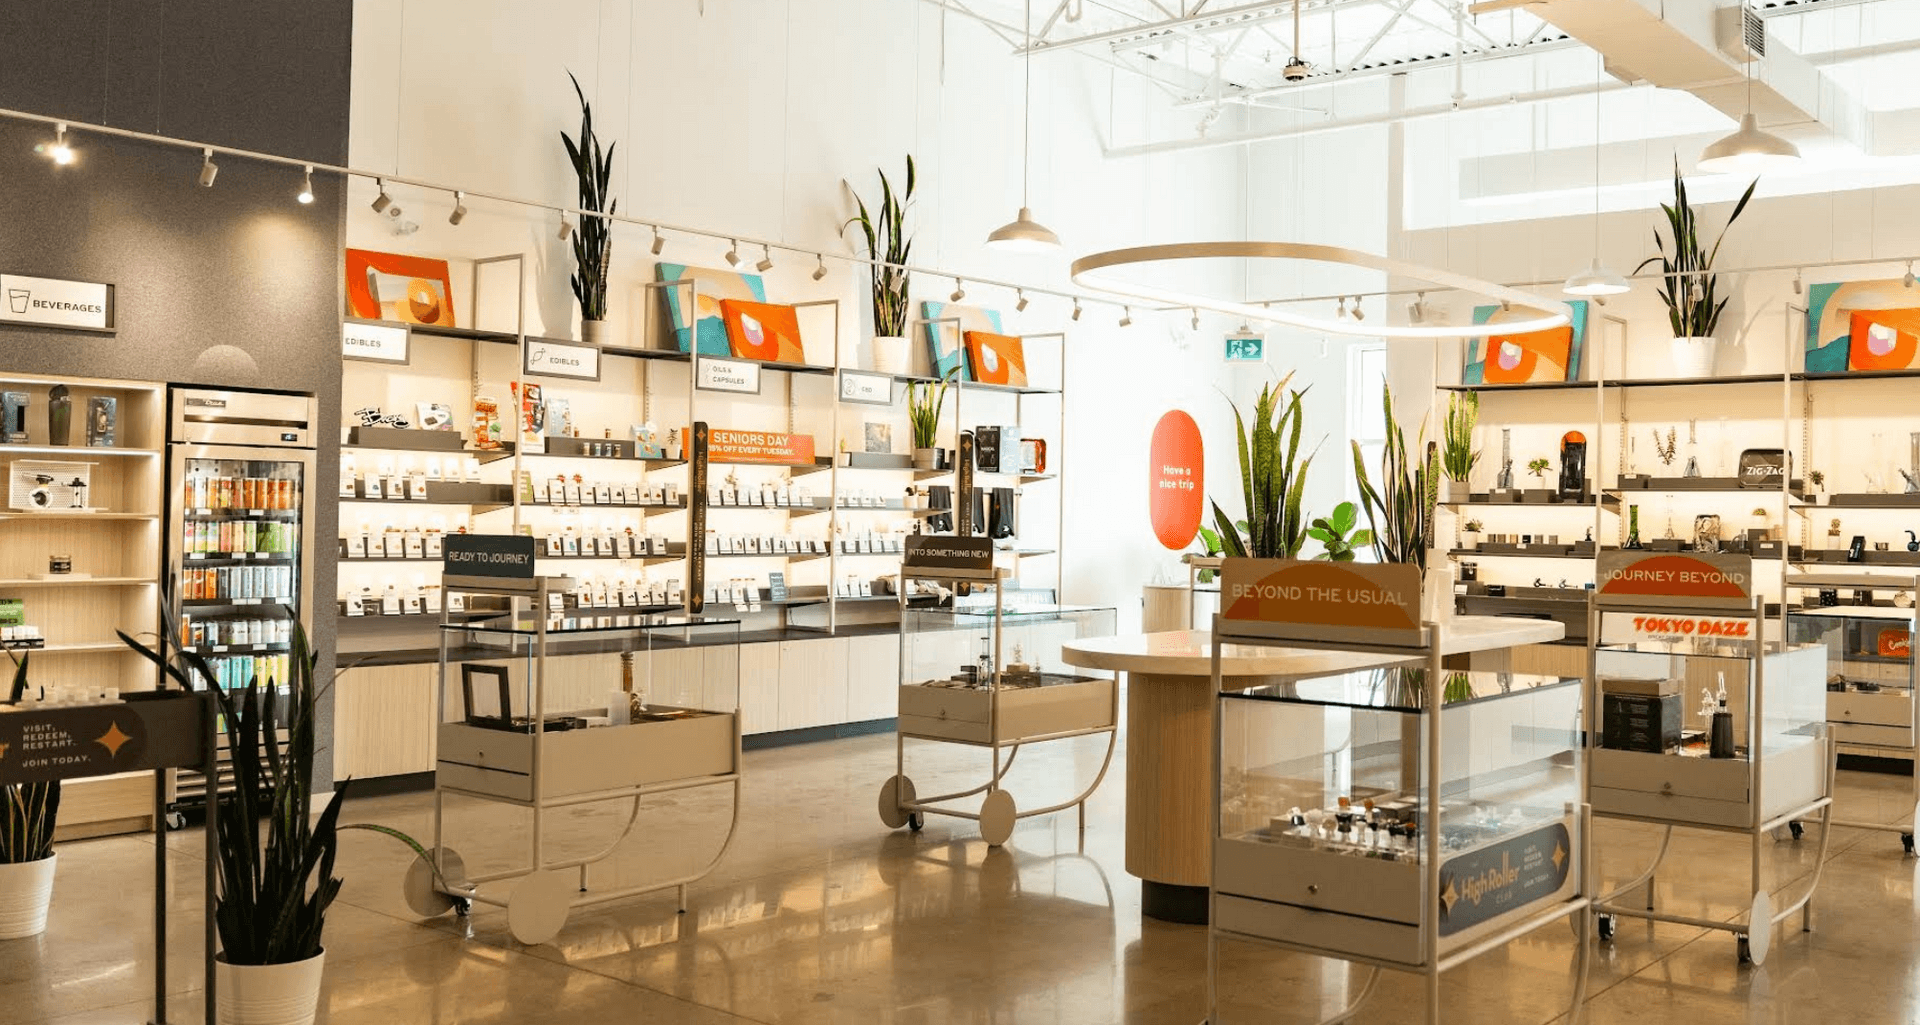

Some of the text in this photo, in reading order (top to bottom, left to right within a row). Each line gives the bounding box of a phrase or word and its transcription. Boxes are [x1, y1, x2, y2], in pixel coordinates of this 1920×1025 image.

[33, 299, 102, 313] BEVERAGES
[345, 338, 381, 348] EDIBLES
[549, 357, 580, 367] EDIBLES
[712, 376, 745, 385] CAPSULES
[714, 432, 789, 447] SENIORS DAY
[723, 445, 737, 453] OFF
[738, 446, 760, 454] EVERY
[1163, 464, 1184, 475] Have
[1159, 479, 1195, 492] nice trip
[448, 551, 530, 565] READY TO JOURNEY
[907, 548, 990, 559] INTO SOMETHING NEW
[1604, 569, 1744, 584] JOURNEY BEYOND
[1232, 583, 1408, 606] BEYOND THE USUAL
[1633, 616, 1750, 637] TOKYO DAZE
[23, 724, 56, 733] VISIT,
[23, 731, 71, 741] REDEEM,
[23, 739, 78, 750] RESTART.
[22, 755, 92, 768] JOIN TODAY.
